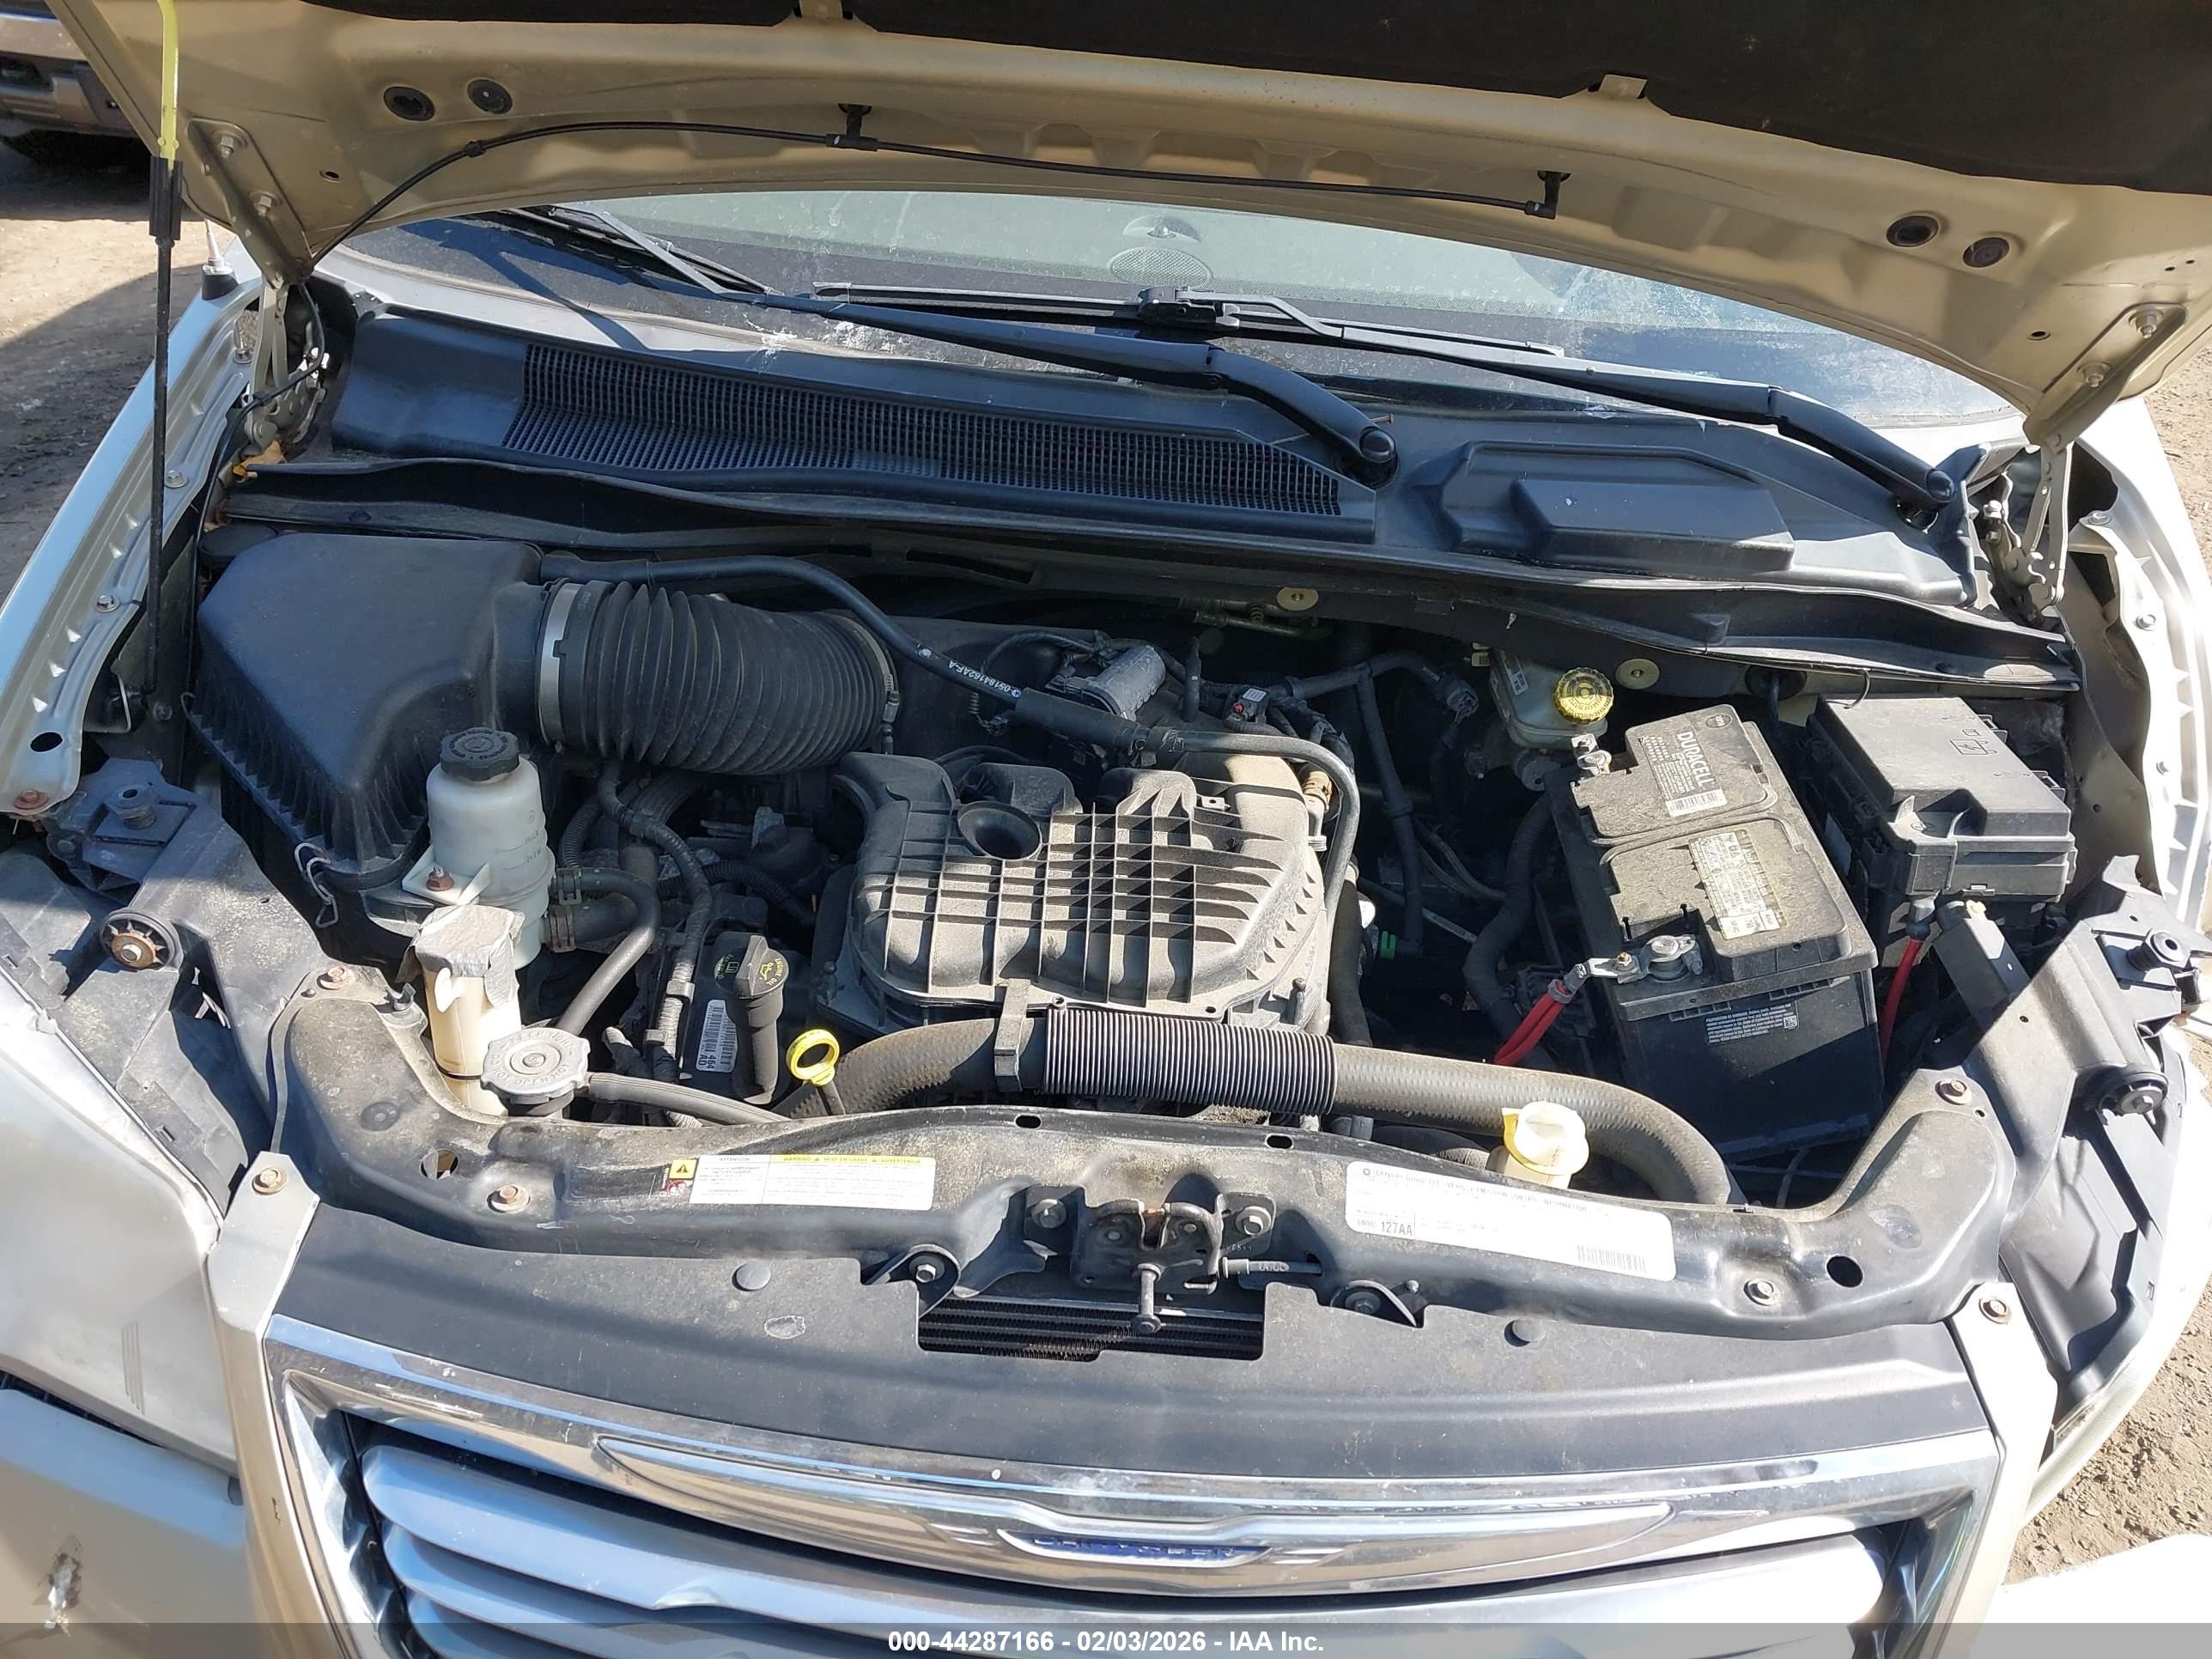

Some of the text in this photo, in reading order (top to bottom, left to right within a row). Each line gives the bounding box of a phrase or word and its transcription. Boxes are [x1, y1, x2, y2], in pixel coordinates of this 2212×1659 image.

[1676, 731, 1715, 788] DURACELL
[698, 1054, 708, 1066] AD
[706, 1054, 717, 1069] 464
[1381, 1220, 1413, 1237] 127AA
